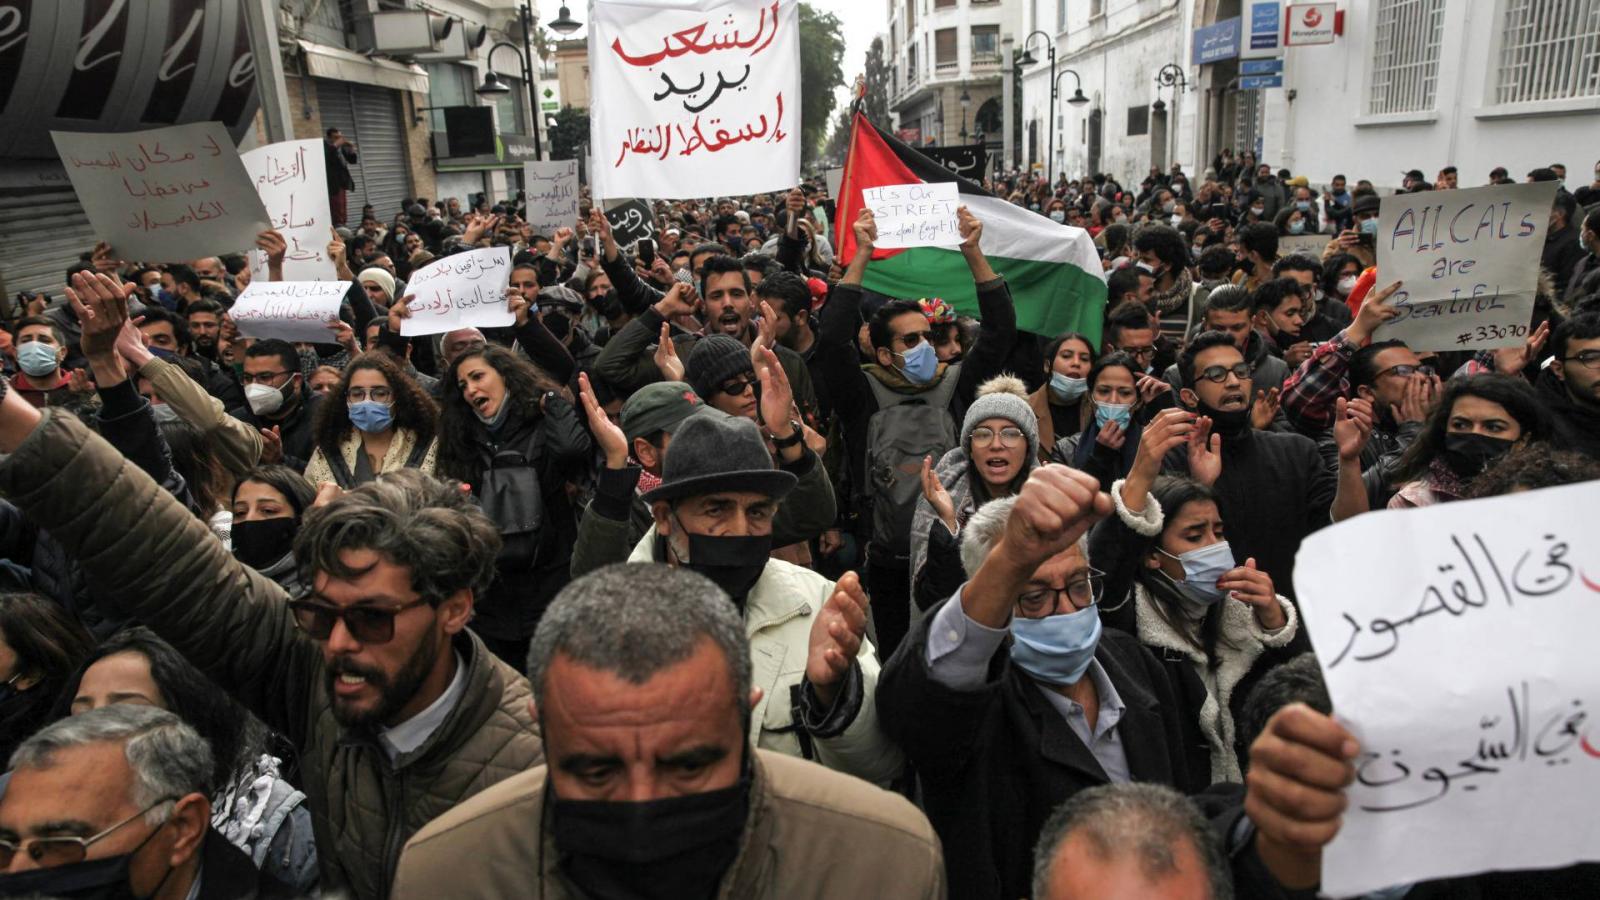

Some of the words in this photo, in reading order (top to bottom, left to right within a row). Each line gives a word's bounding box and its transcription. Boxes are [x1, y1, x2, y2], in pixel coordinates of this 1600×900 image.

[611, 1, 779, 71] الشعب
[1292, 29, 1331, 37] MoneyGram
[653, 64, 750, 114] يريد
[202, 134, 221, 157] لا
[615, 123, 671, 168] النظام
[680, 91, 786, 156] إسقاط
[126, 142, 195, 172] مكان
[1431, 257, 1476, 280] are
[1455, 324, 1527, 345] #33070
[1328, 532, 1514, 668] القصور
[1533, 699, 1588, 766] في
